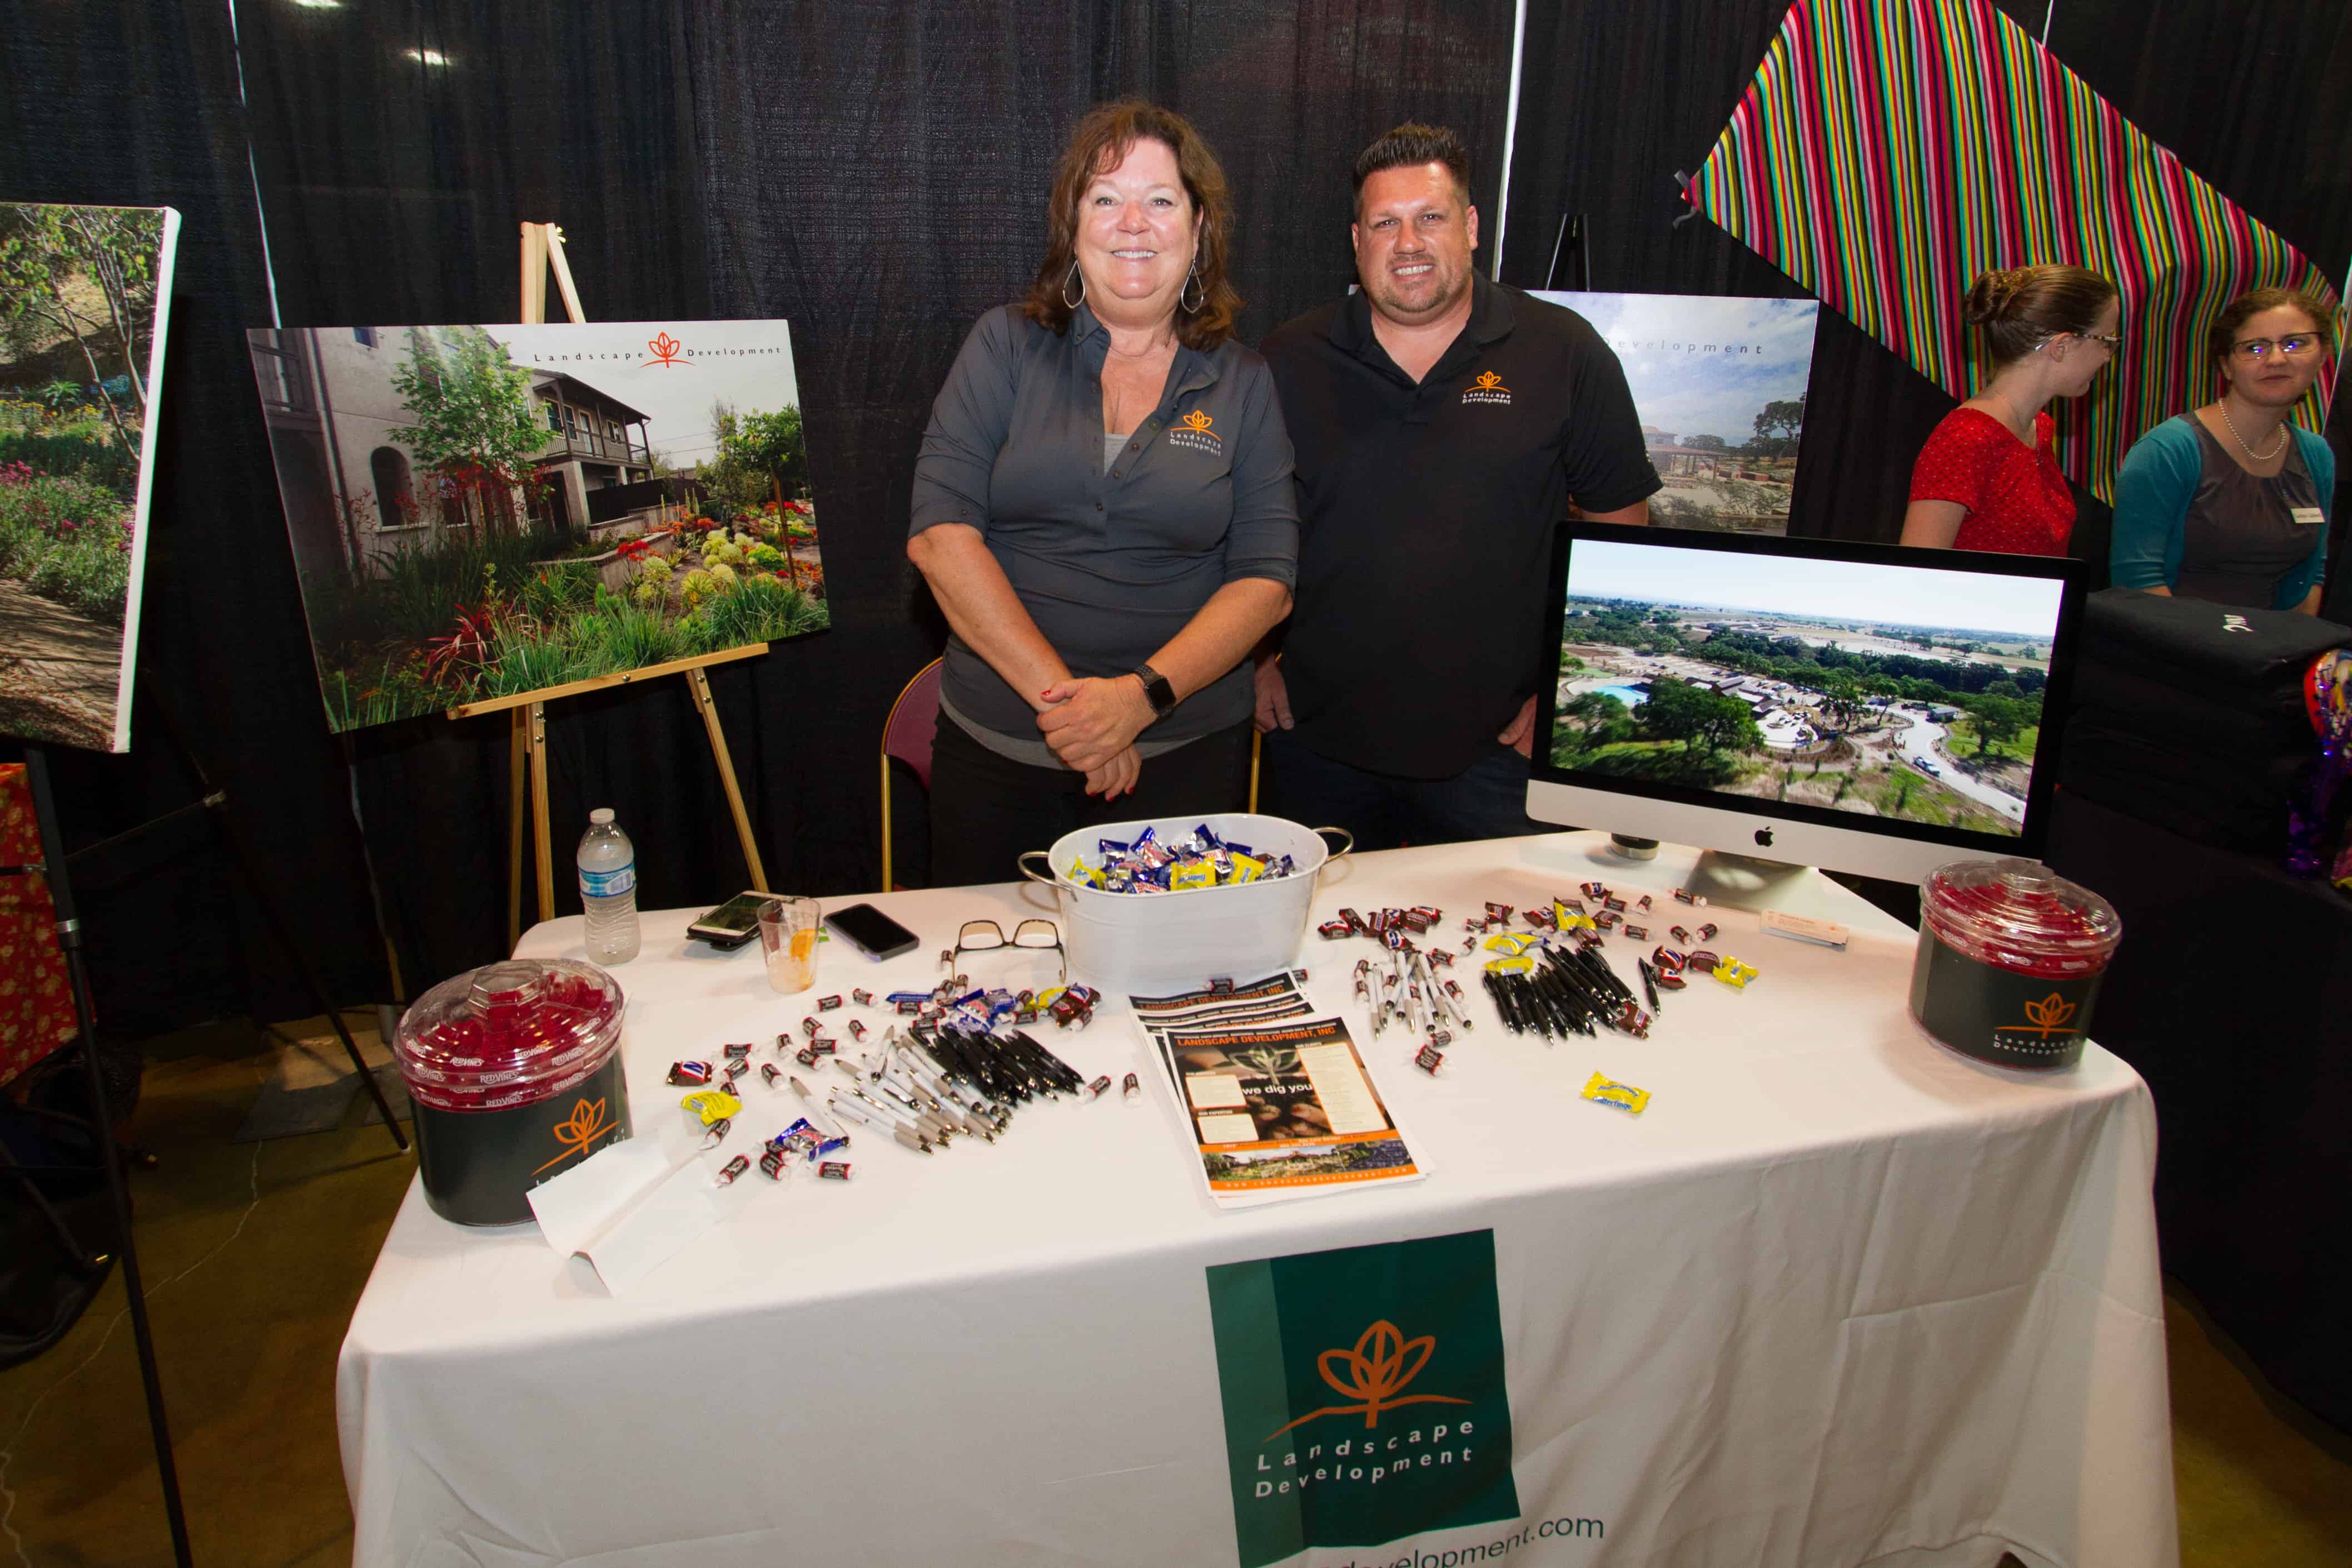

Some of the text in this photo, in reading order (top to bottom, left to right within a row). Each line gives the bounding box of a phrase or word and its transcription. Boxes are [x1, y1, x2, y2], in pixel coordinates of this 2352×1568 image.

[534, 347, 781, 362] Landscape Development
[1170, 431, 1221, 448] Landscape
[1170, 439, 1221, 456] Development
[1176, 1036, 1237, 1047] LANDSCAPE
[1240, 1029, 1317, 1043] DEVELOPMENT,
[1317, 1027, 1335, 1036] INC
[1242, 1084, 1314, 1095] we dig you
[1256, 1420, 1474, 1471] Landscape
[1254, 1447, 1473, 1498] Development
[1345, 1517, 1604, 1568] elopment.com
